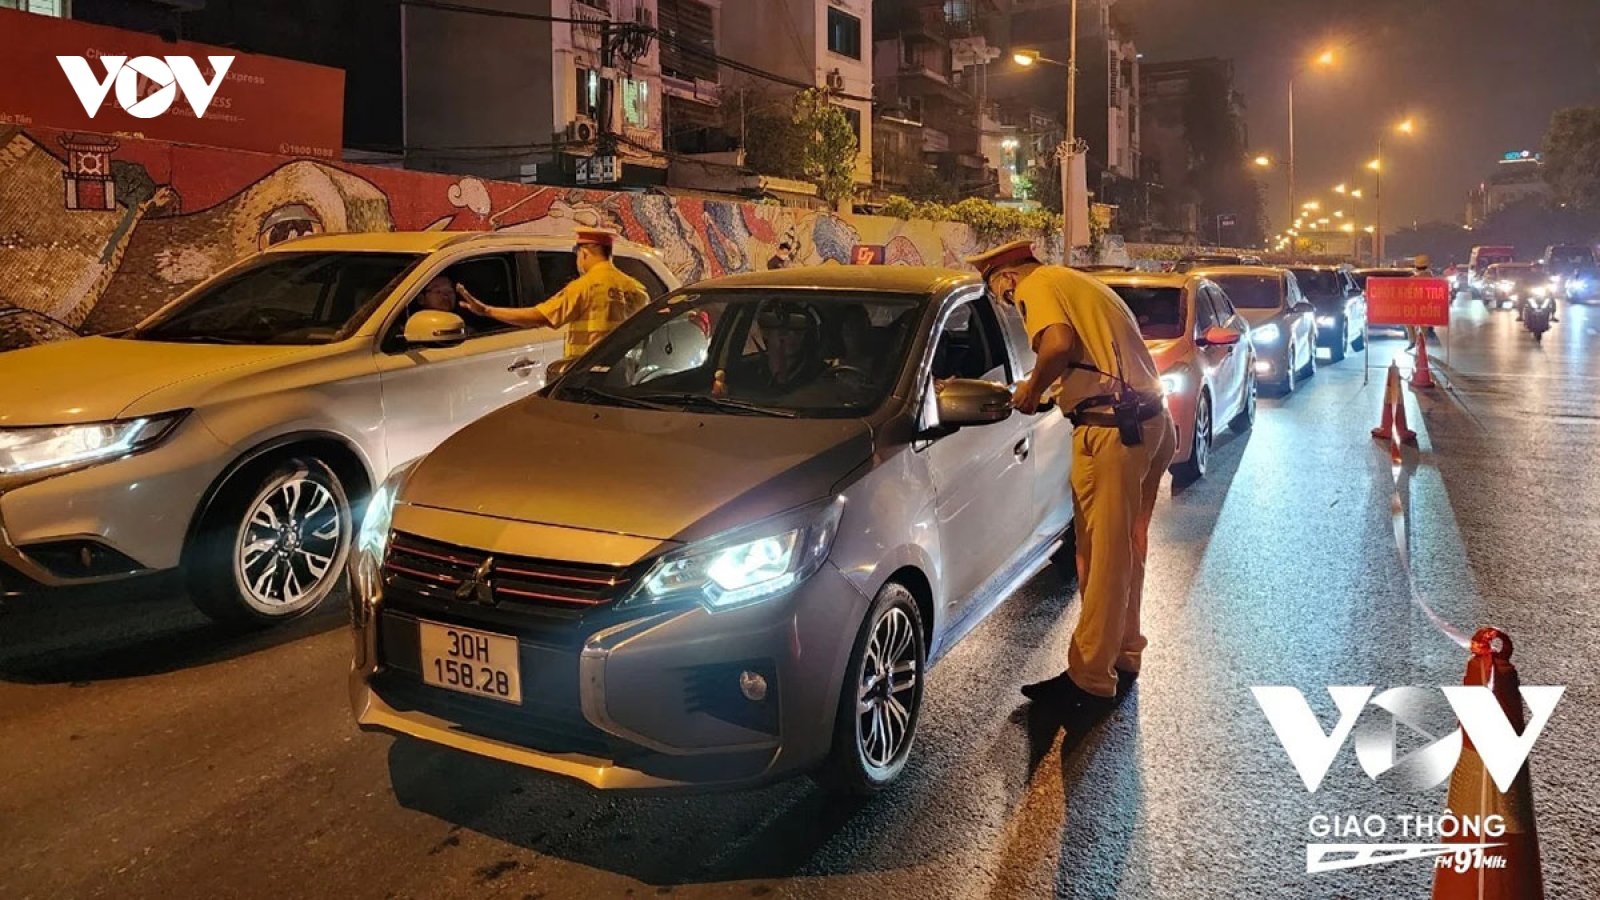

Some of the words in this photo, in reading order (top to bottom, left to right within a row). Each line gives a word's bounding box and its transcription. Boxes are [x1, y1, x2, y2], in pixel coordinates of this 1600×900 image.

[225, 71, 265, 85] Express
[1425, 286, 1445, 300] TRA
[447, 631, 489, 663] 30H
[434, 658, 509, 696] 158.28
